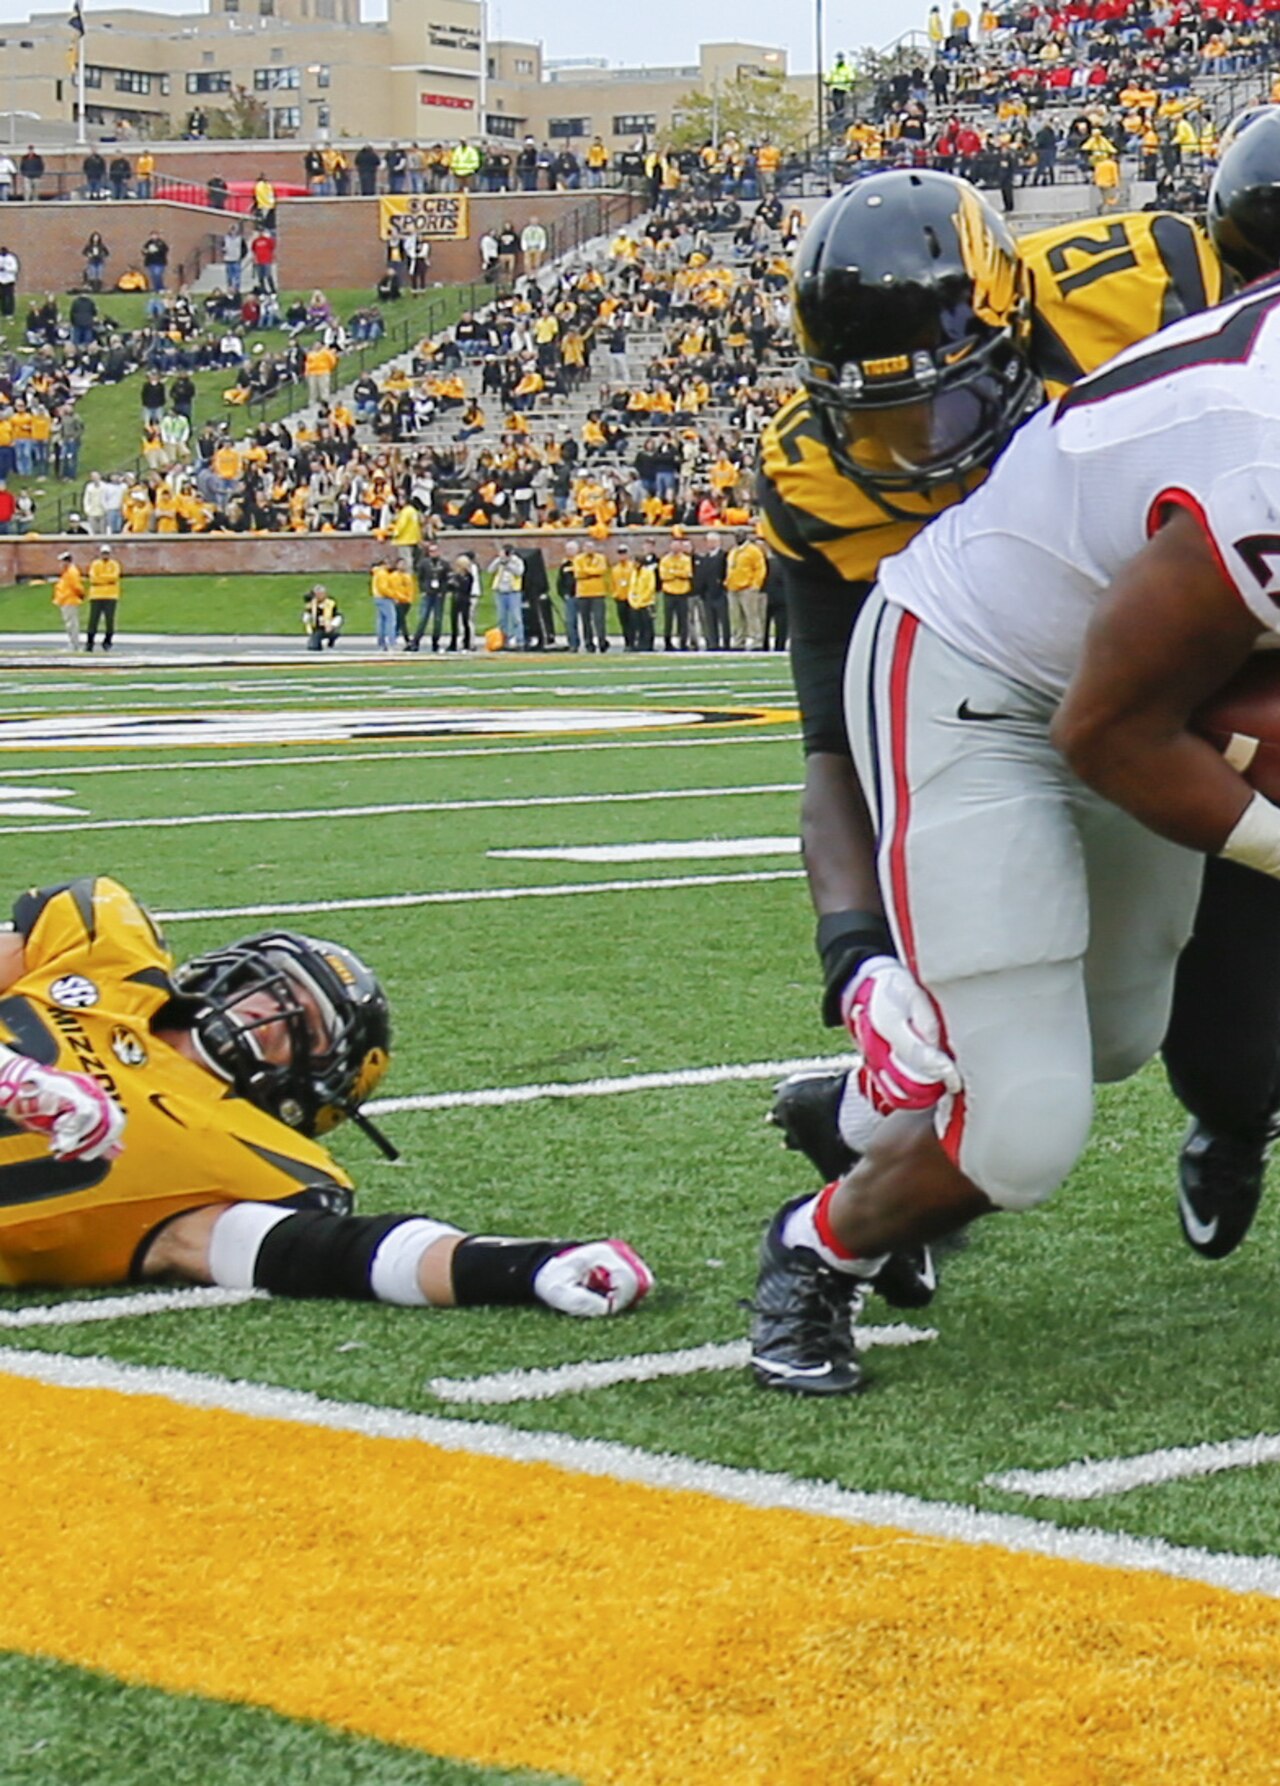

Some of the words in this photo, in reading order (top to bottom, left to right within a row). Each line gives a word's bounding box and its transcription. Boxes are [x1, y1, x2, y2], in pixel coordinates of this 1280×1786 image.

[423, 197, 459, 213] CBS
[388, 214, 459, 234] SPORTS
[1045, 221, 1141, 300] 12
[50, 975, 99, 1008] SEC
